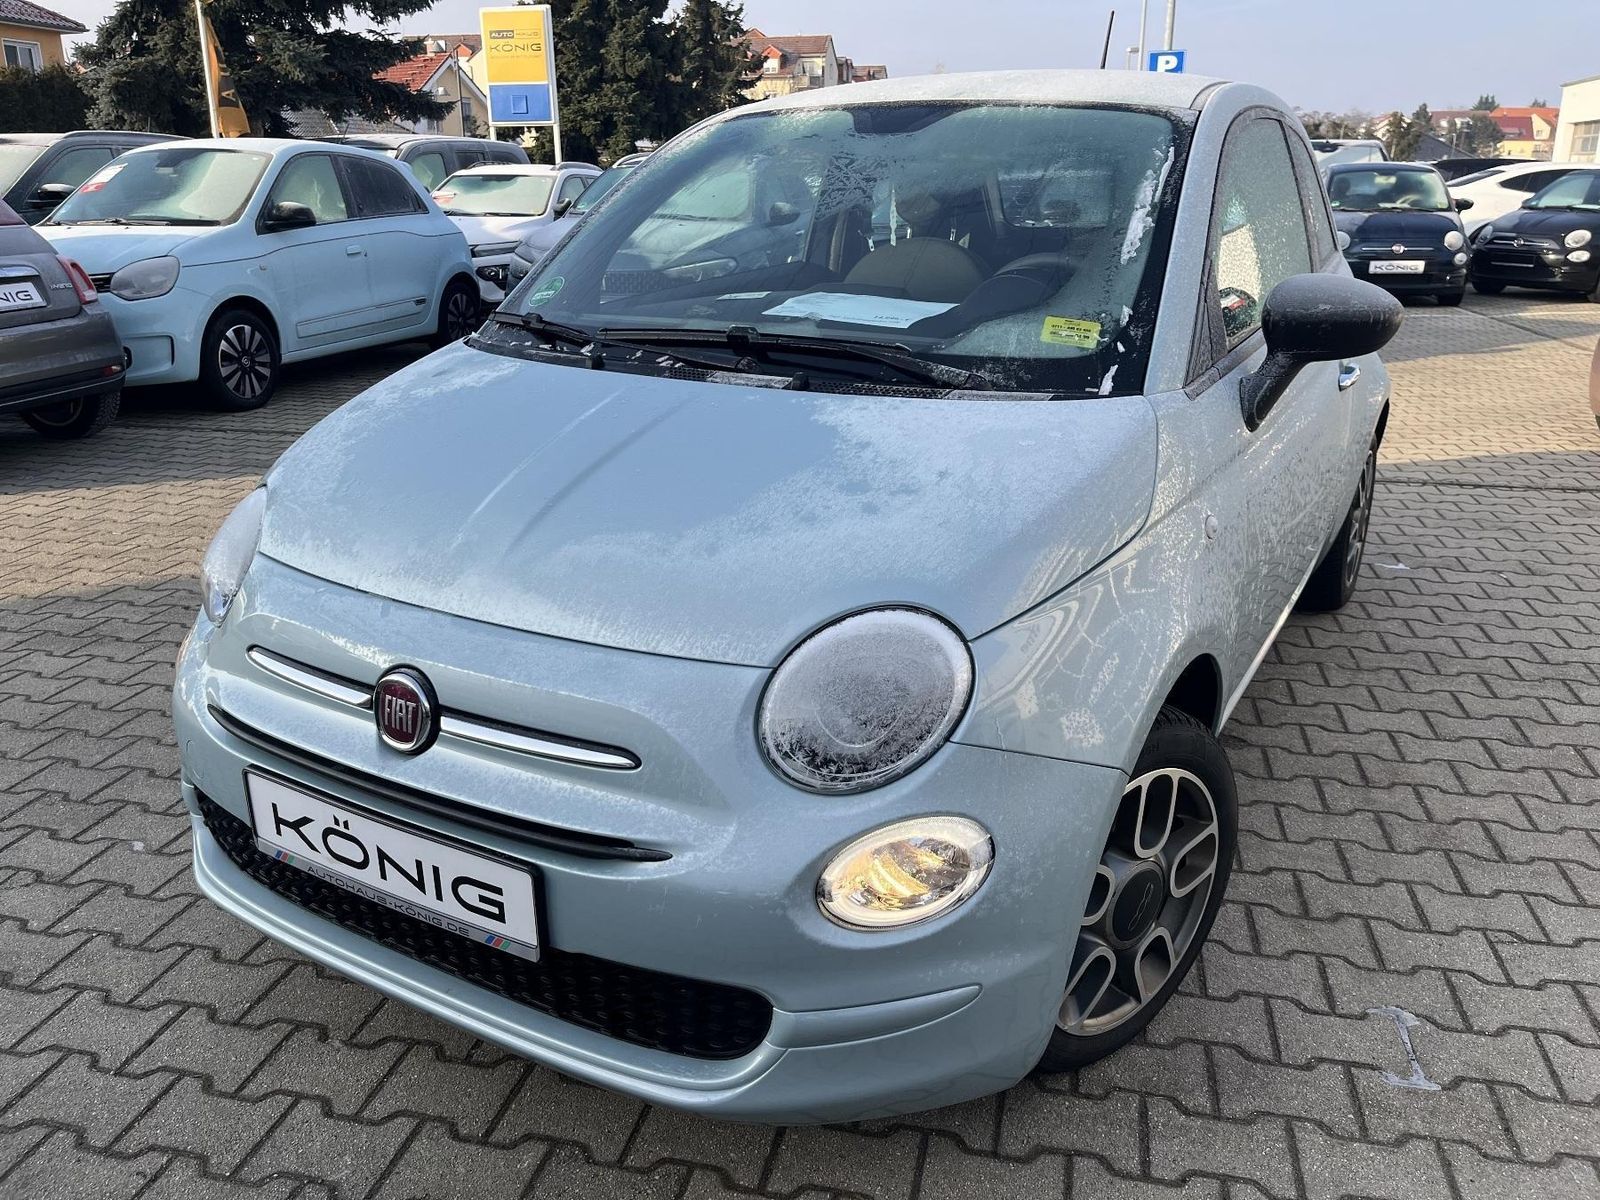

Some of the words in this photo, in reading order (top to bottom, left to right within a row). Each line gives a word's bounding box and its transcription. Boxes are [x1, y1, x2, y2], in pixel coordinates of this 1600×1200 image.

[490, 41, 542, 52] KÖNIG
[1157, 55, 1178, 72] P
[1374, 263, 1419, 271] KÖNIG
[384, 694, 417, 734] FIAT
[271, 802, 506, 924] KÖNIG
